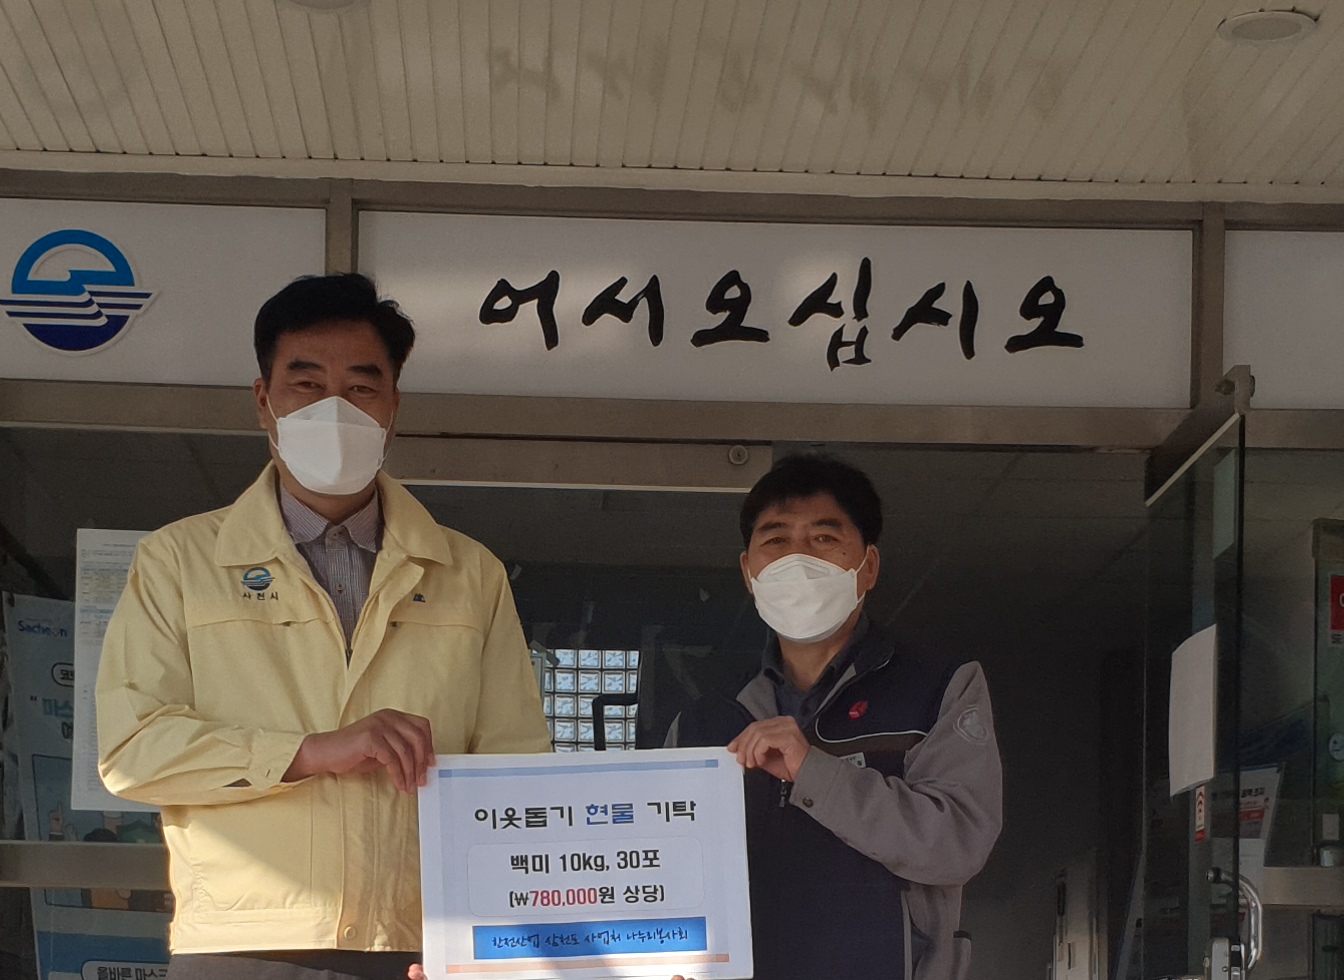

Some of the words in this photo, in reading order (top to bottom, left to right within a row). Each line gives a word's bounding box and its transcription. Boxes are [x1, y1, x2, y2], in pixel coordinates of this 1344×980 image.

[478, 256, 1085, 371] 어서오십시오
[242, 591, 279, 601] 사천시
[473, 803, 575, 830] 이웃돕기
[585, 803, 635, 827] 현물
[646, 801, 697, 822] 기탁
[509, 853, 551, 875] 백미
[559, 852, 611, 873] 10kg,
[616, 849, 662, 870] 30포
